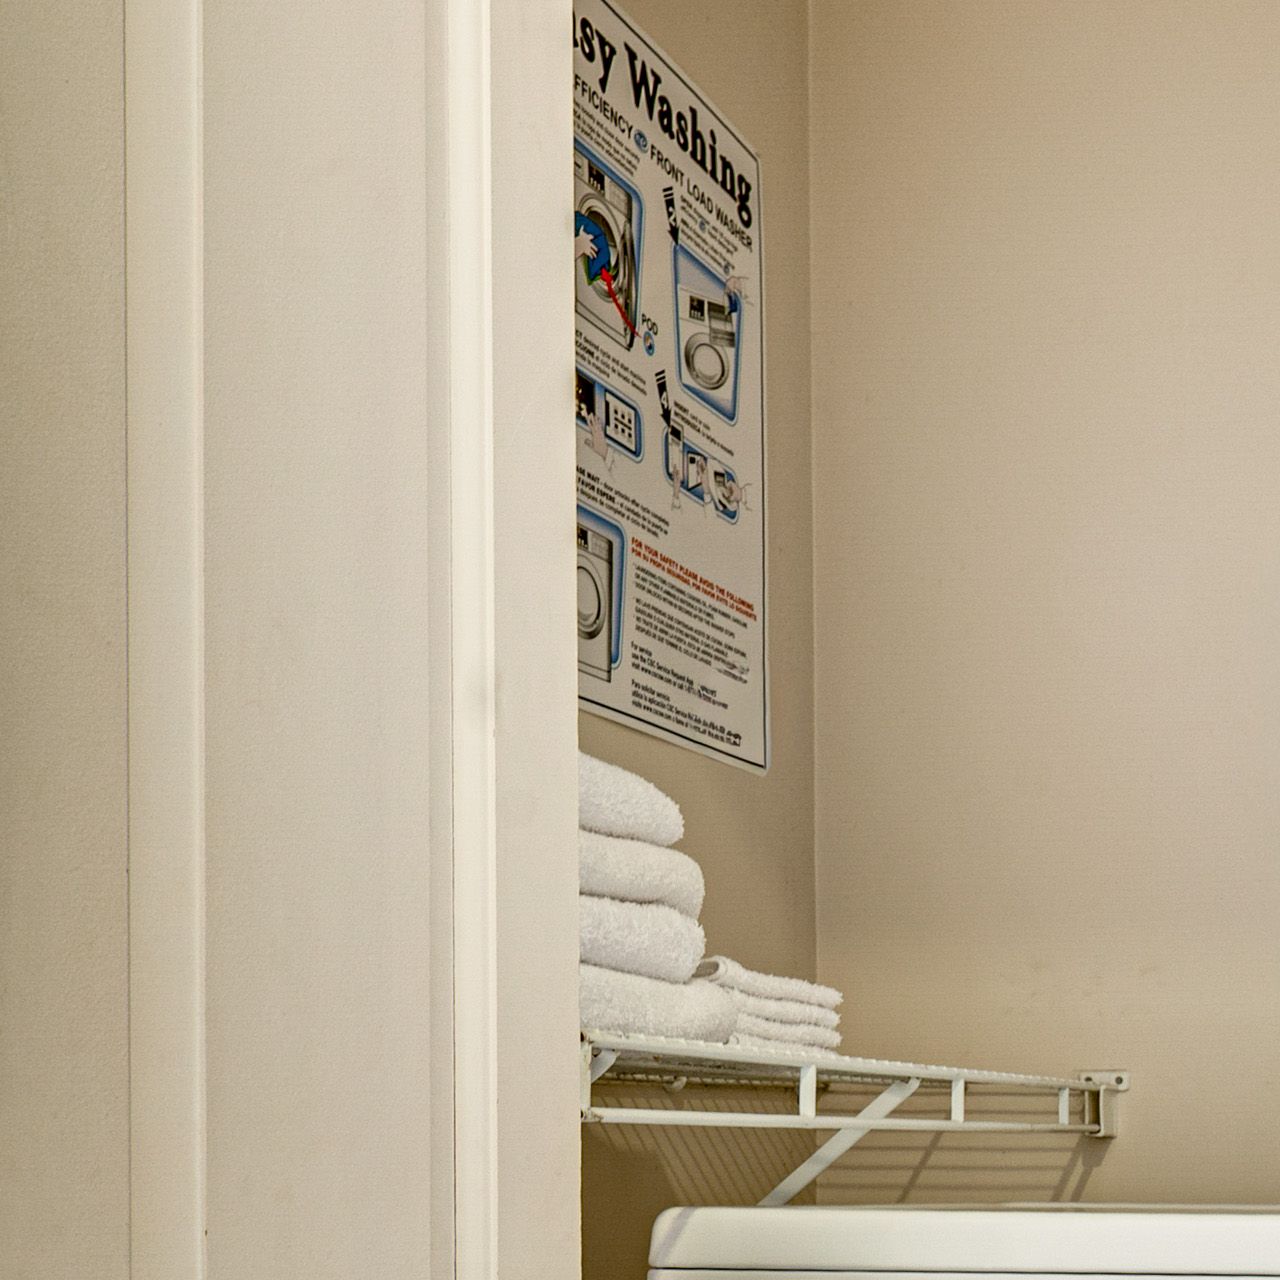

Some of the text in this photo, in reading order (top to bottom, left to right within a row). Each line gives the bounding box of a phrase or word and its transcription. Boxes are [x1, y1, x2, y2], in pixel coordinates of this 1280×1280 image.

[573, 8, 616, 94] sy
[624, 41, 752, 229] Washing
[574, 74, 633, 139] FFICIENCY
[650, 144, 685, 187] FRONT
[688, 178, 714, 214] LOAD
[642, 314, 658, 336] POD
